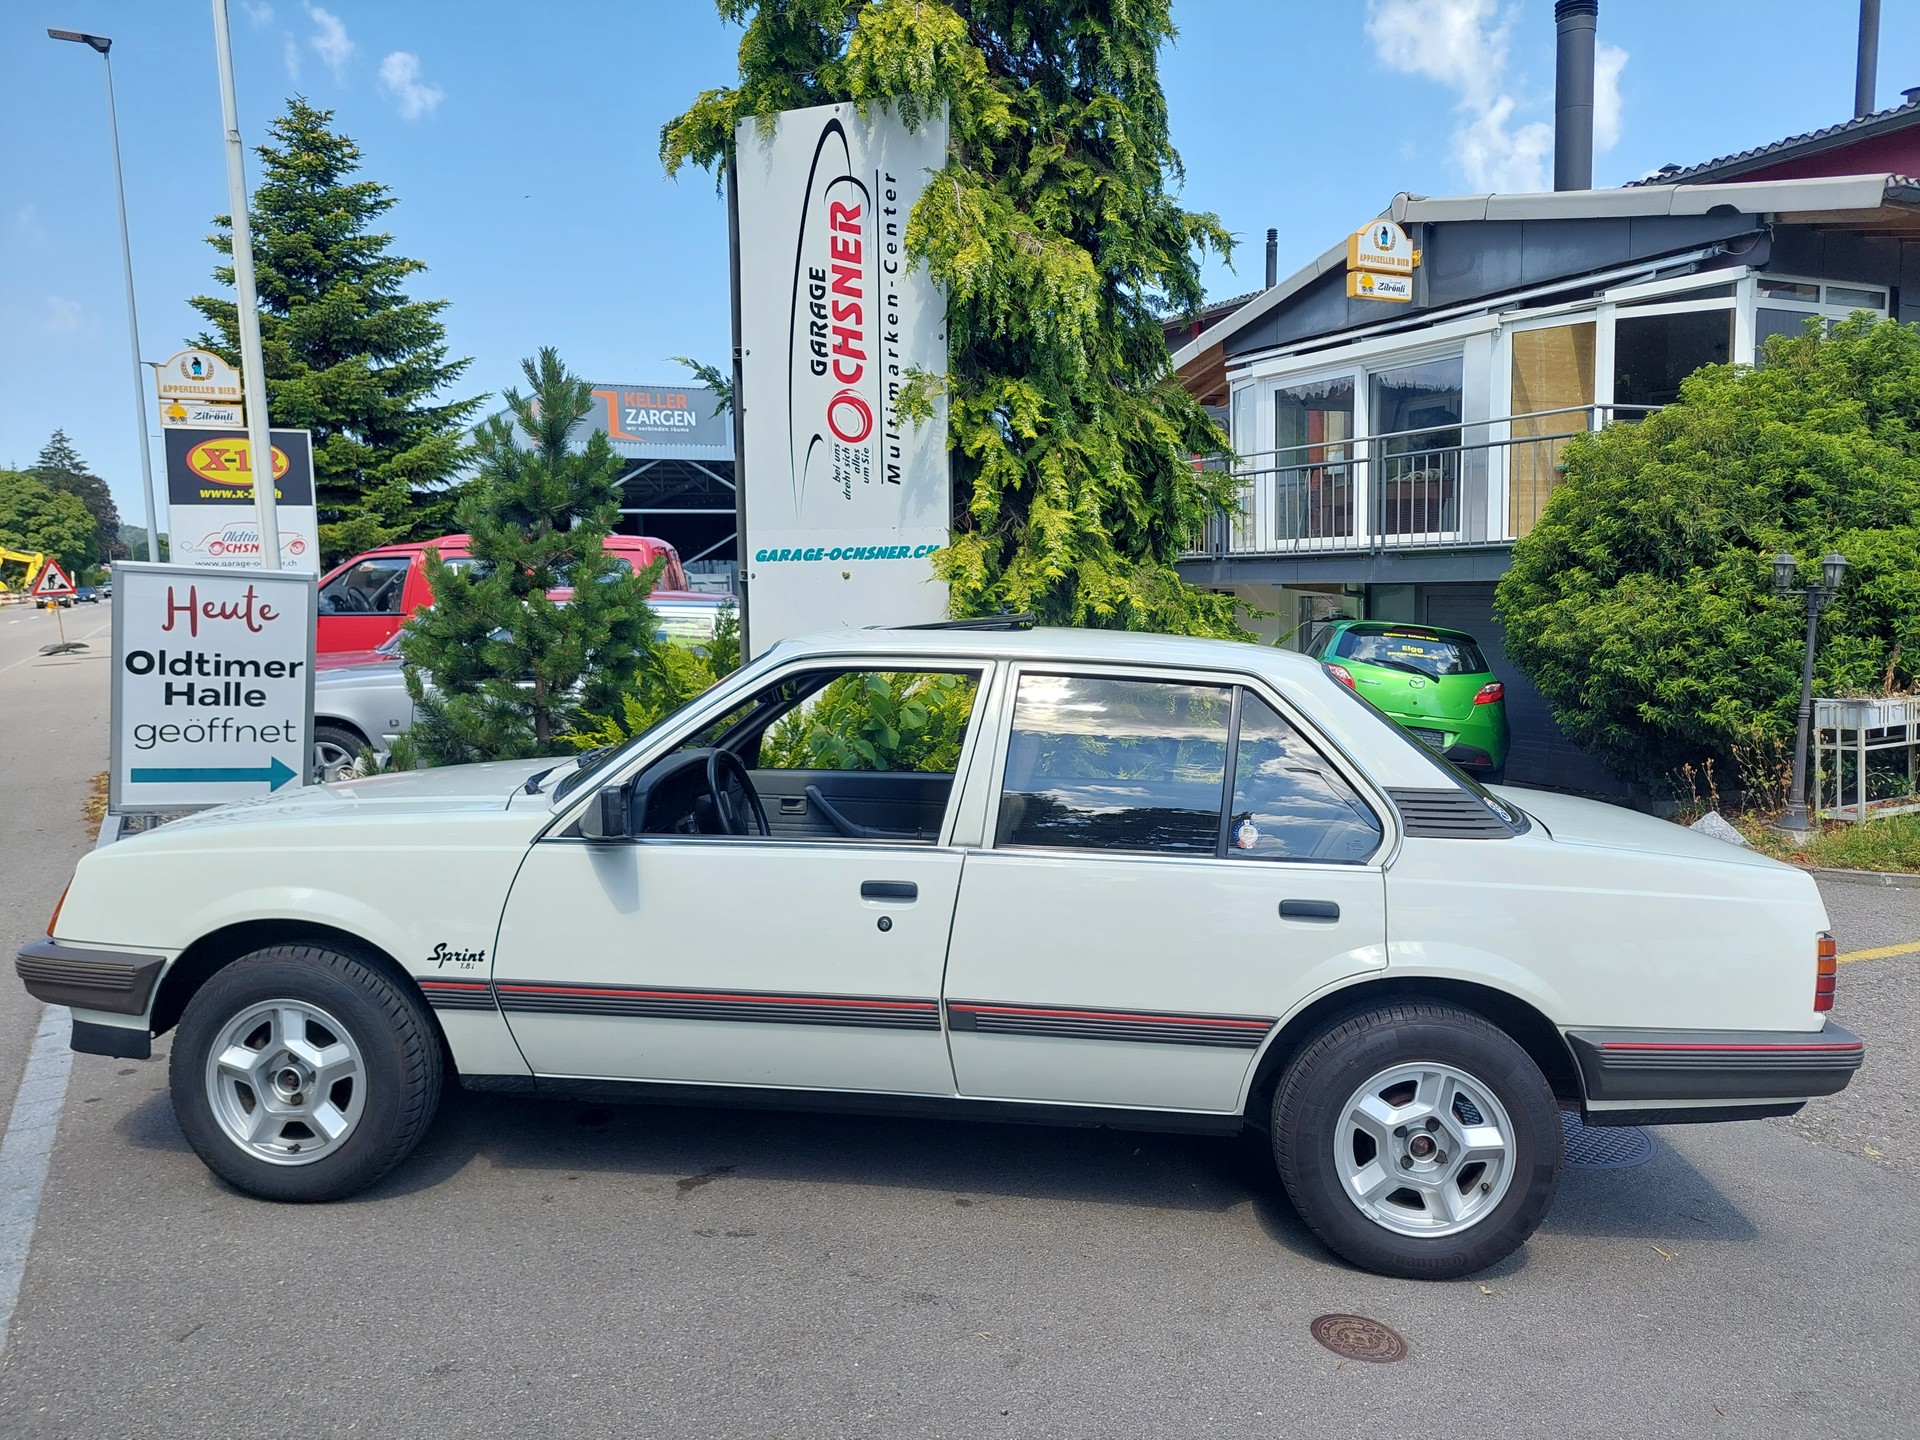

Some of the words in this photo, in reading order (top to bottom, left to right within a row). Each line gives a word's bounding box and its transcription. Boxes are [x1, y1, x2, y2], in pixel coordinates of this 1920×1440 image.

[1397, 257, 1410, 268] BIER
[808, 266, 829, 376] GARAGE
[828, 200, 873, 443] OCHSNER
[883, 172, 901, 486] Multimarken-Center
[163, 384, 216, 395] APPENZELLER
[218, 387, 237, 396] BIER
[624, 391, 687, 409] KELLER
[625, 408, 697, 427] ZARGEN
[842, 447, 851, 468] sich
[852, 448, 860, 474] alles
[861, 447, 870, 465] Sie
[832, 464, 841, 483] bei
[863, 467, 869, 484] um
[200, 489, 282, 498] www.x-1h
[842, 470, 851, 500] dreht
[208, 541, 259, 556] OCHSN
[195, 560, 297, 568] www.garage-or.ch
[161, 584, 280, 638] Heute
[1402, 645, 1424, 654] Elgg
[125, 649, 304, 679] Oldtimer
[164, 681, 267, 708] Halle
[133, 717, 297, 750] geöffnet
[427, 942, 485, 968] Sprint
